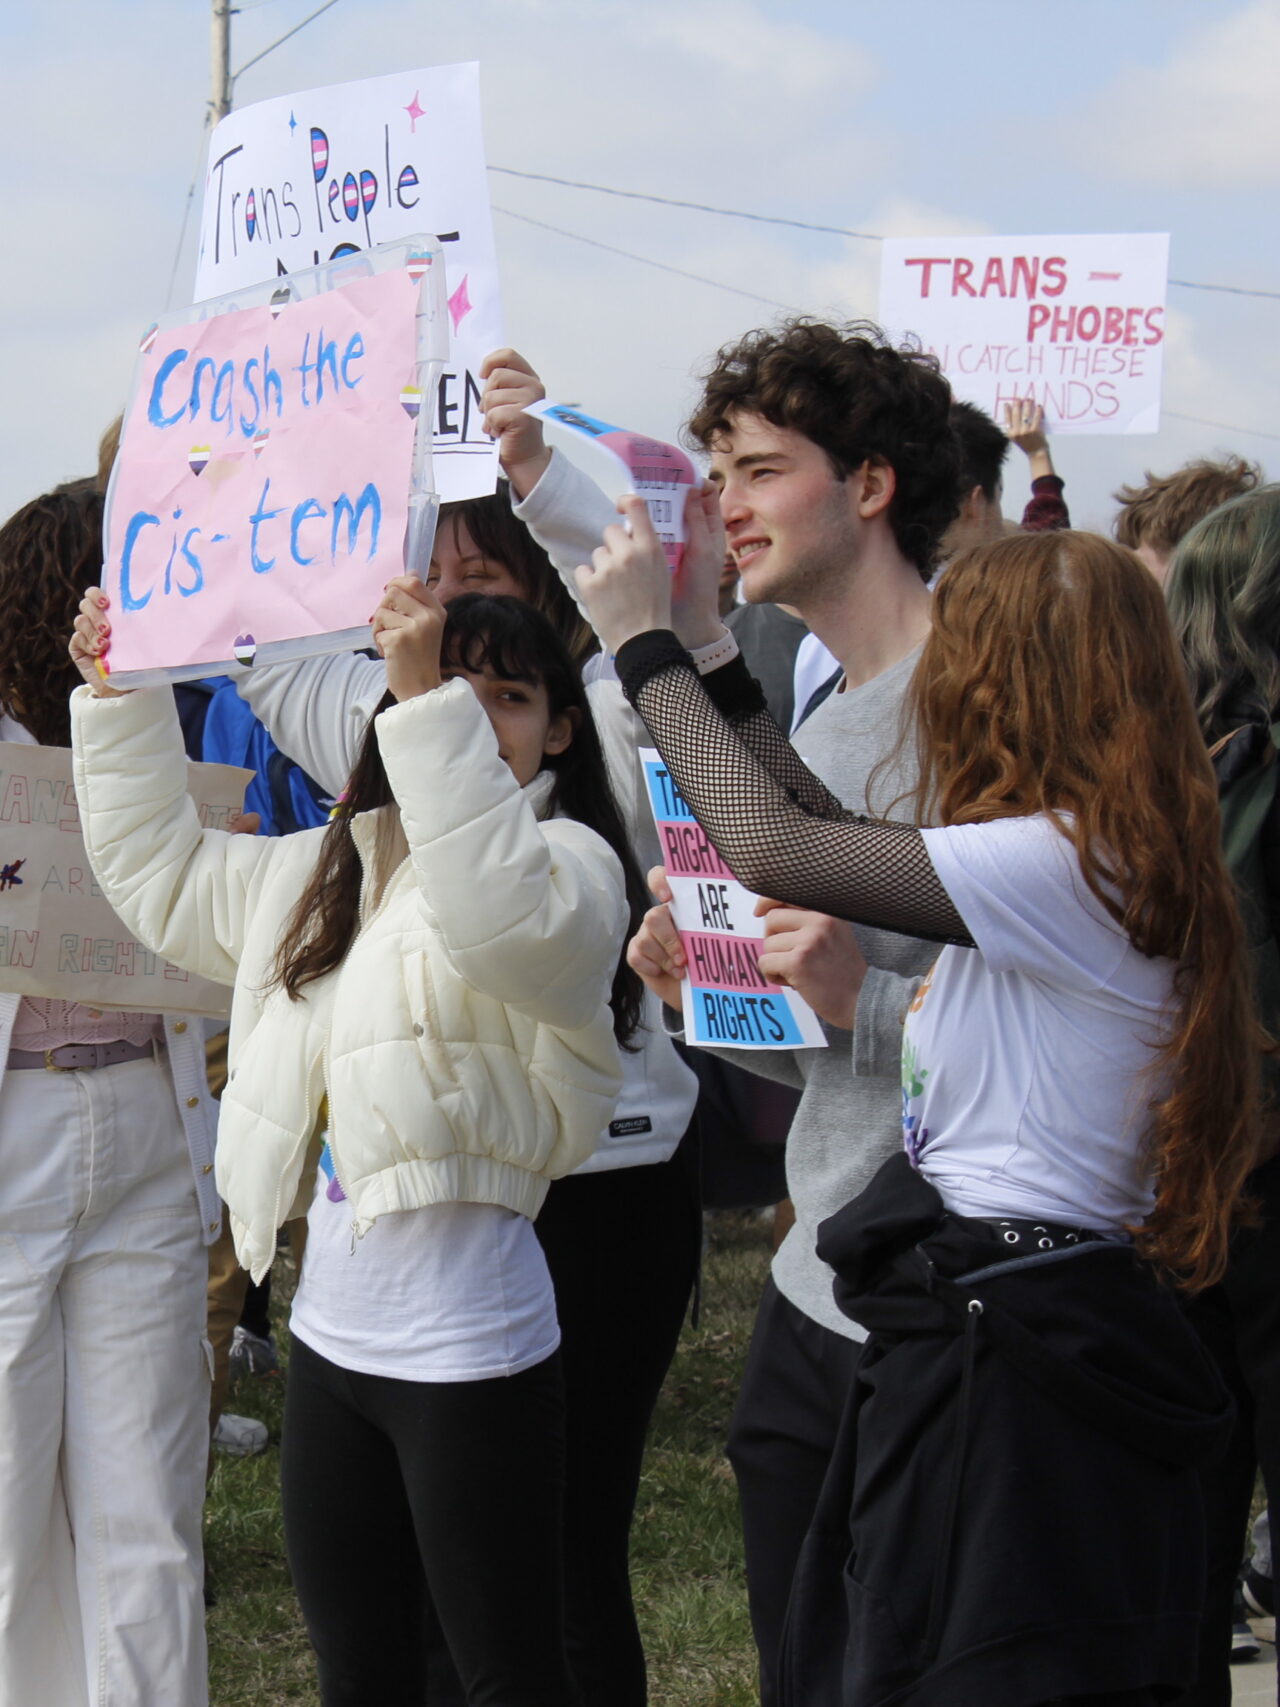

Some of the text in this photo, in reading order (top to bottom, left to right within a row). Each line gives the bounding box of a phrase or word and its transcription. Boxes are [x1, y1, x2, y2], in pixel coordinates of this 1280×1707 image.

[212, 123, 421, 265] Trans People
[904, 256, 1068, 300] TRANS
[1026, 303, 1165, 347] PHOBES
[147, 343, 284, 439] Crash
[291, 324, 367, 410] the
[957, 344, 1045, 375] CATCH
[1055, 345, 1147, 378] THESE
[993, 381, 1121, 421] HANDS
[119, 476, 384, 615] Cis-tem
[664, 826, 724, 875] RIGH
[41, 864, 102, 898] ARE
[697, 883, 734, 931] ARE
[690, 936, 768, 988] HUMAN
[703, 992, 785, 1042] RIGHTS
